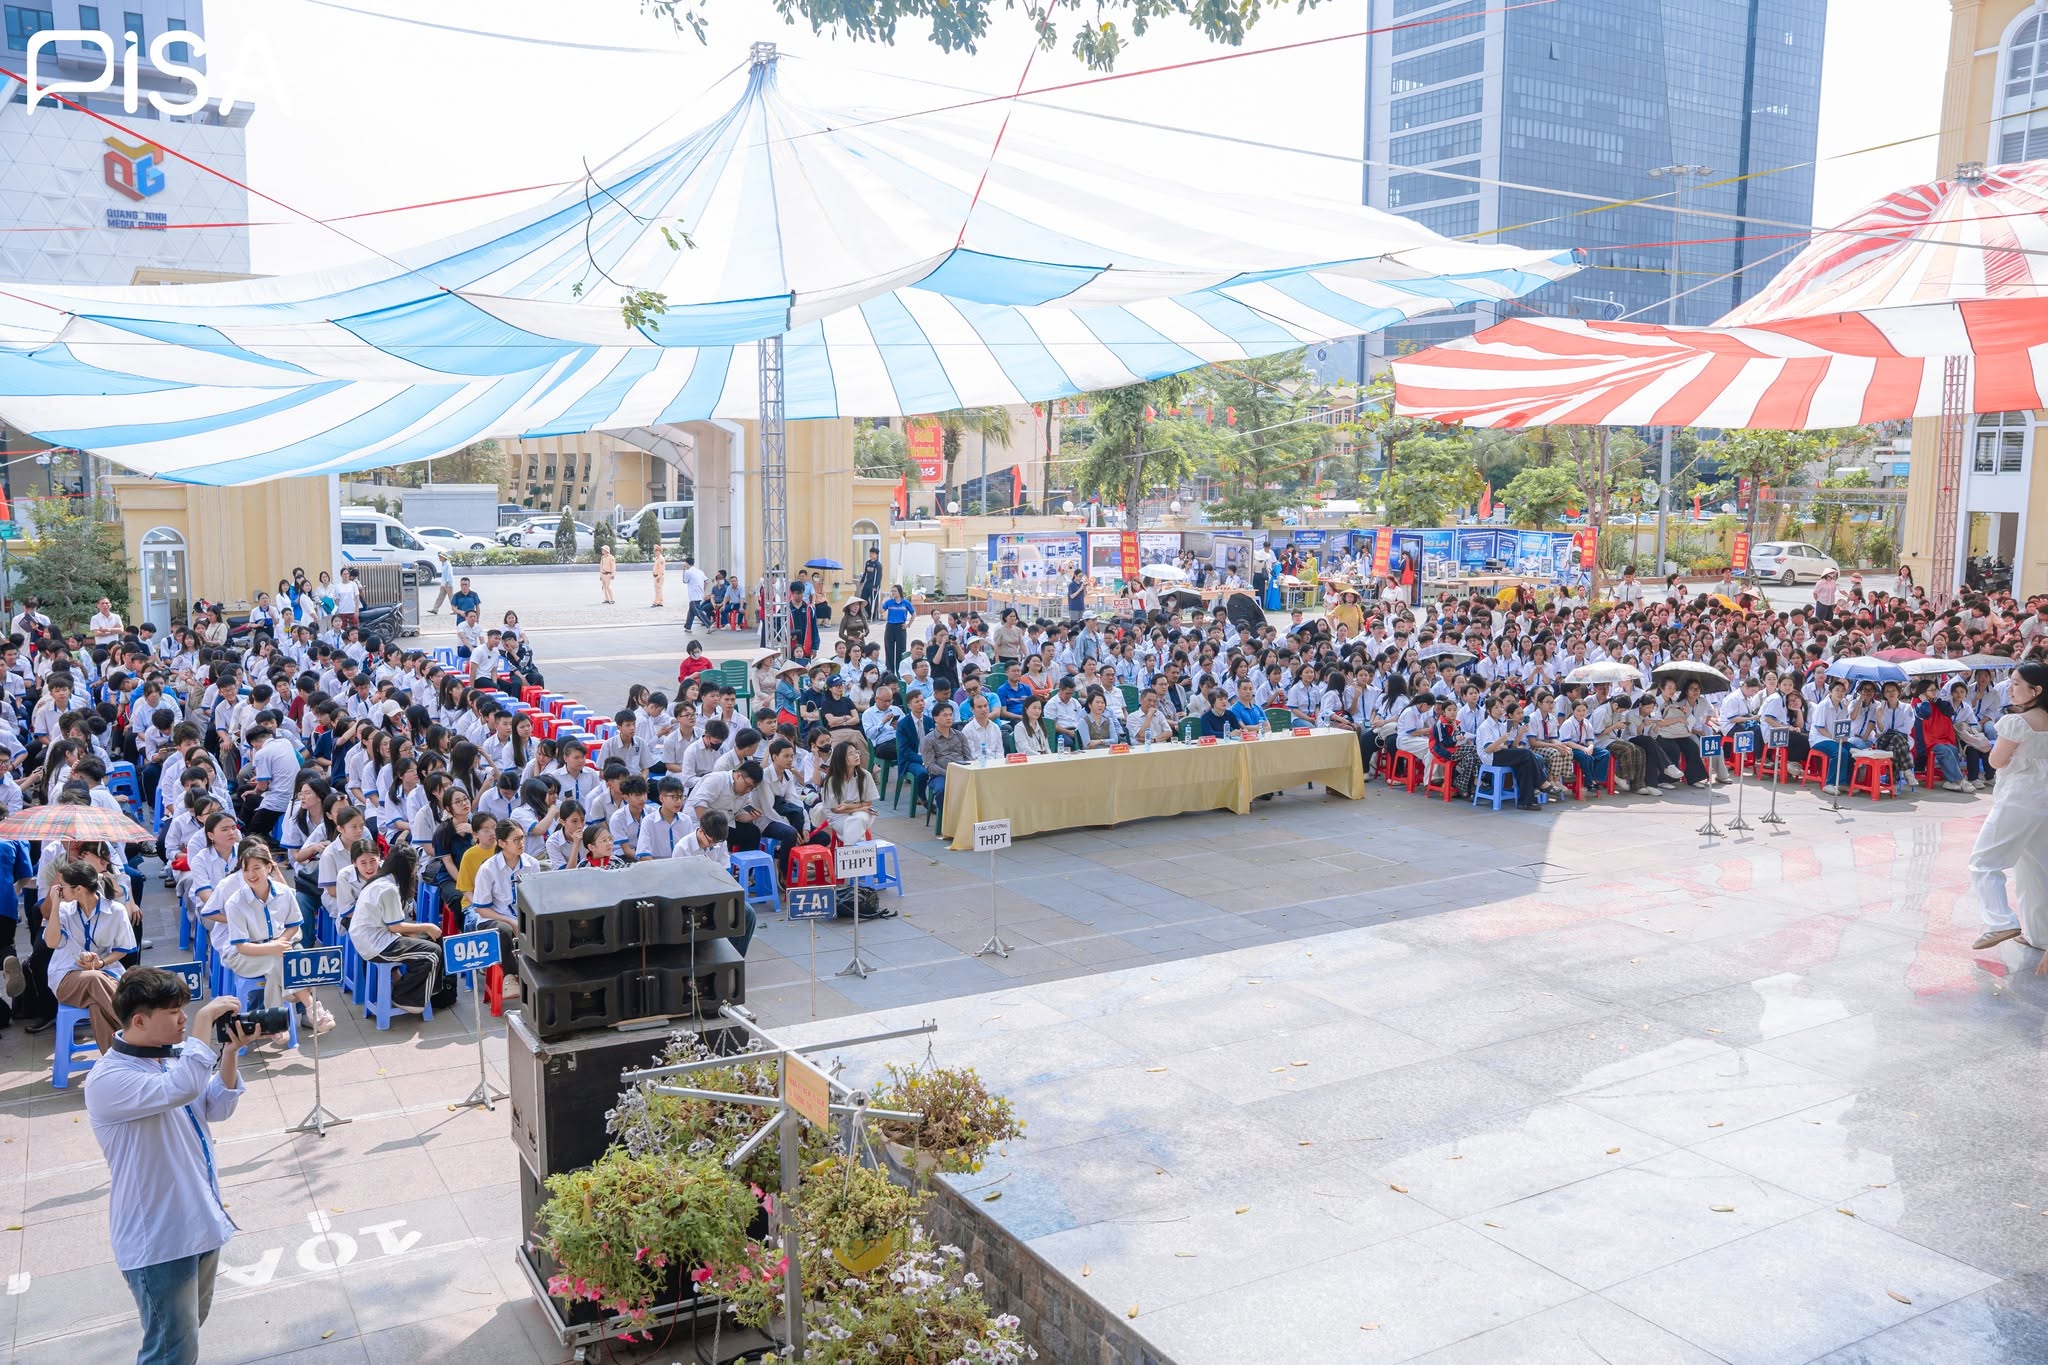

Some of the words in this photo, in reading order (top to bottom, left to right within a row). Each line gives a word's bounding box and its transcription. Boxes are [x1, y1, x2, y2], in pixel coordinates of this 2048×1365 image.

[145, 211, 167, 221] NINH
[108, 219, 135, 230] MEDIA
[138, 221, 168, 232] GROUP
[979, 833, 1007, 846] THPT
[840, 856, 875, 870] THPT
[796, 894, 807, 911] 7
[811, 893, 828, 909] A1
[453, 940, 490, 962] 9A2
[288, 957, 312, 977] 10
[317, 955, 340, 974] A2
